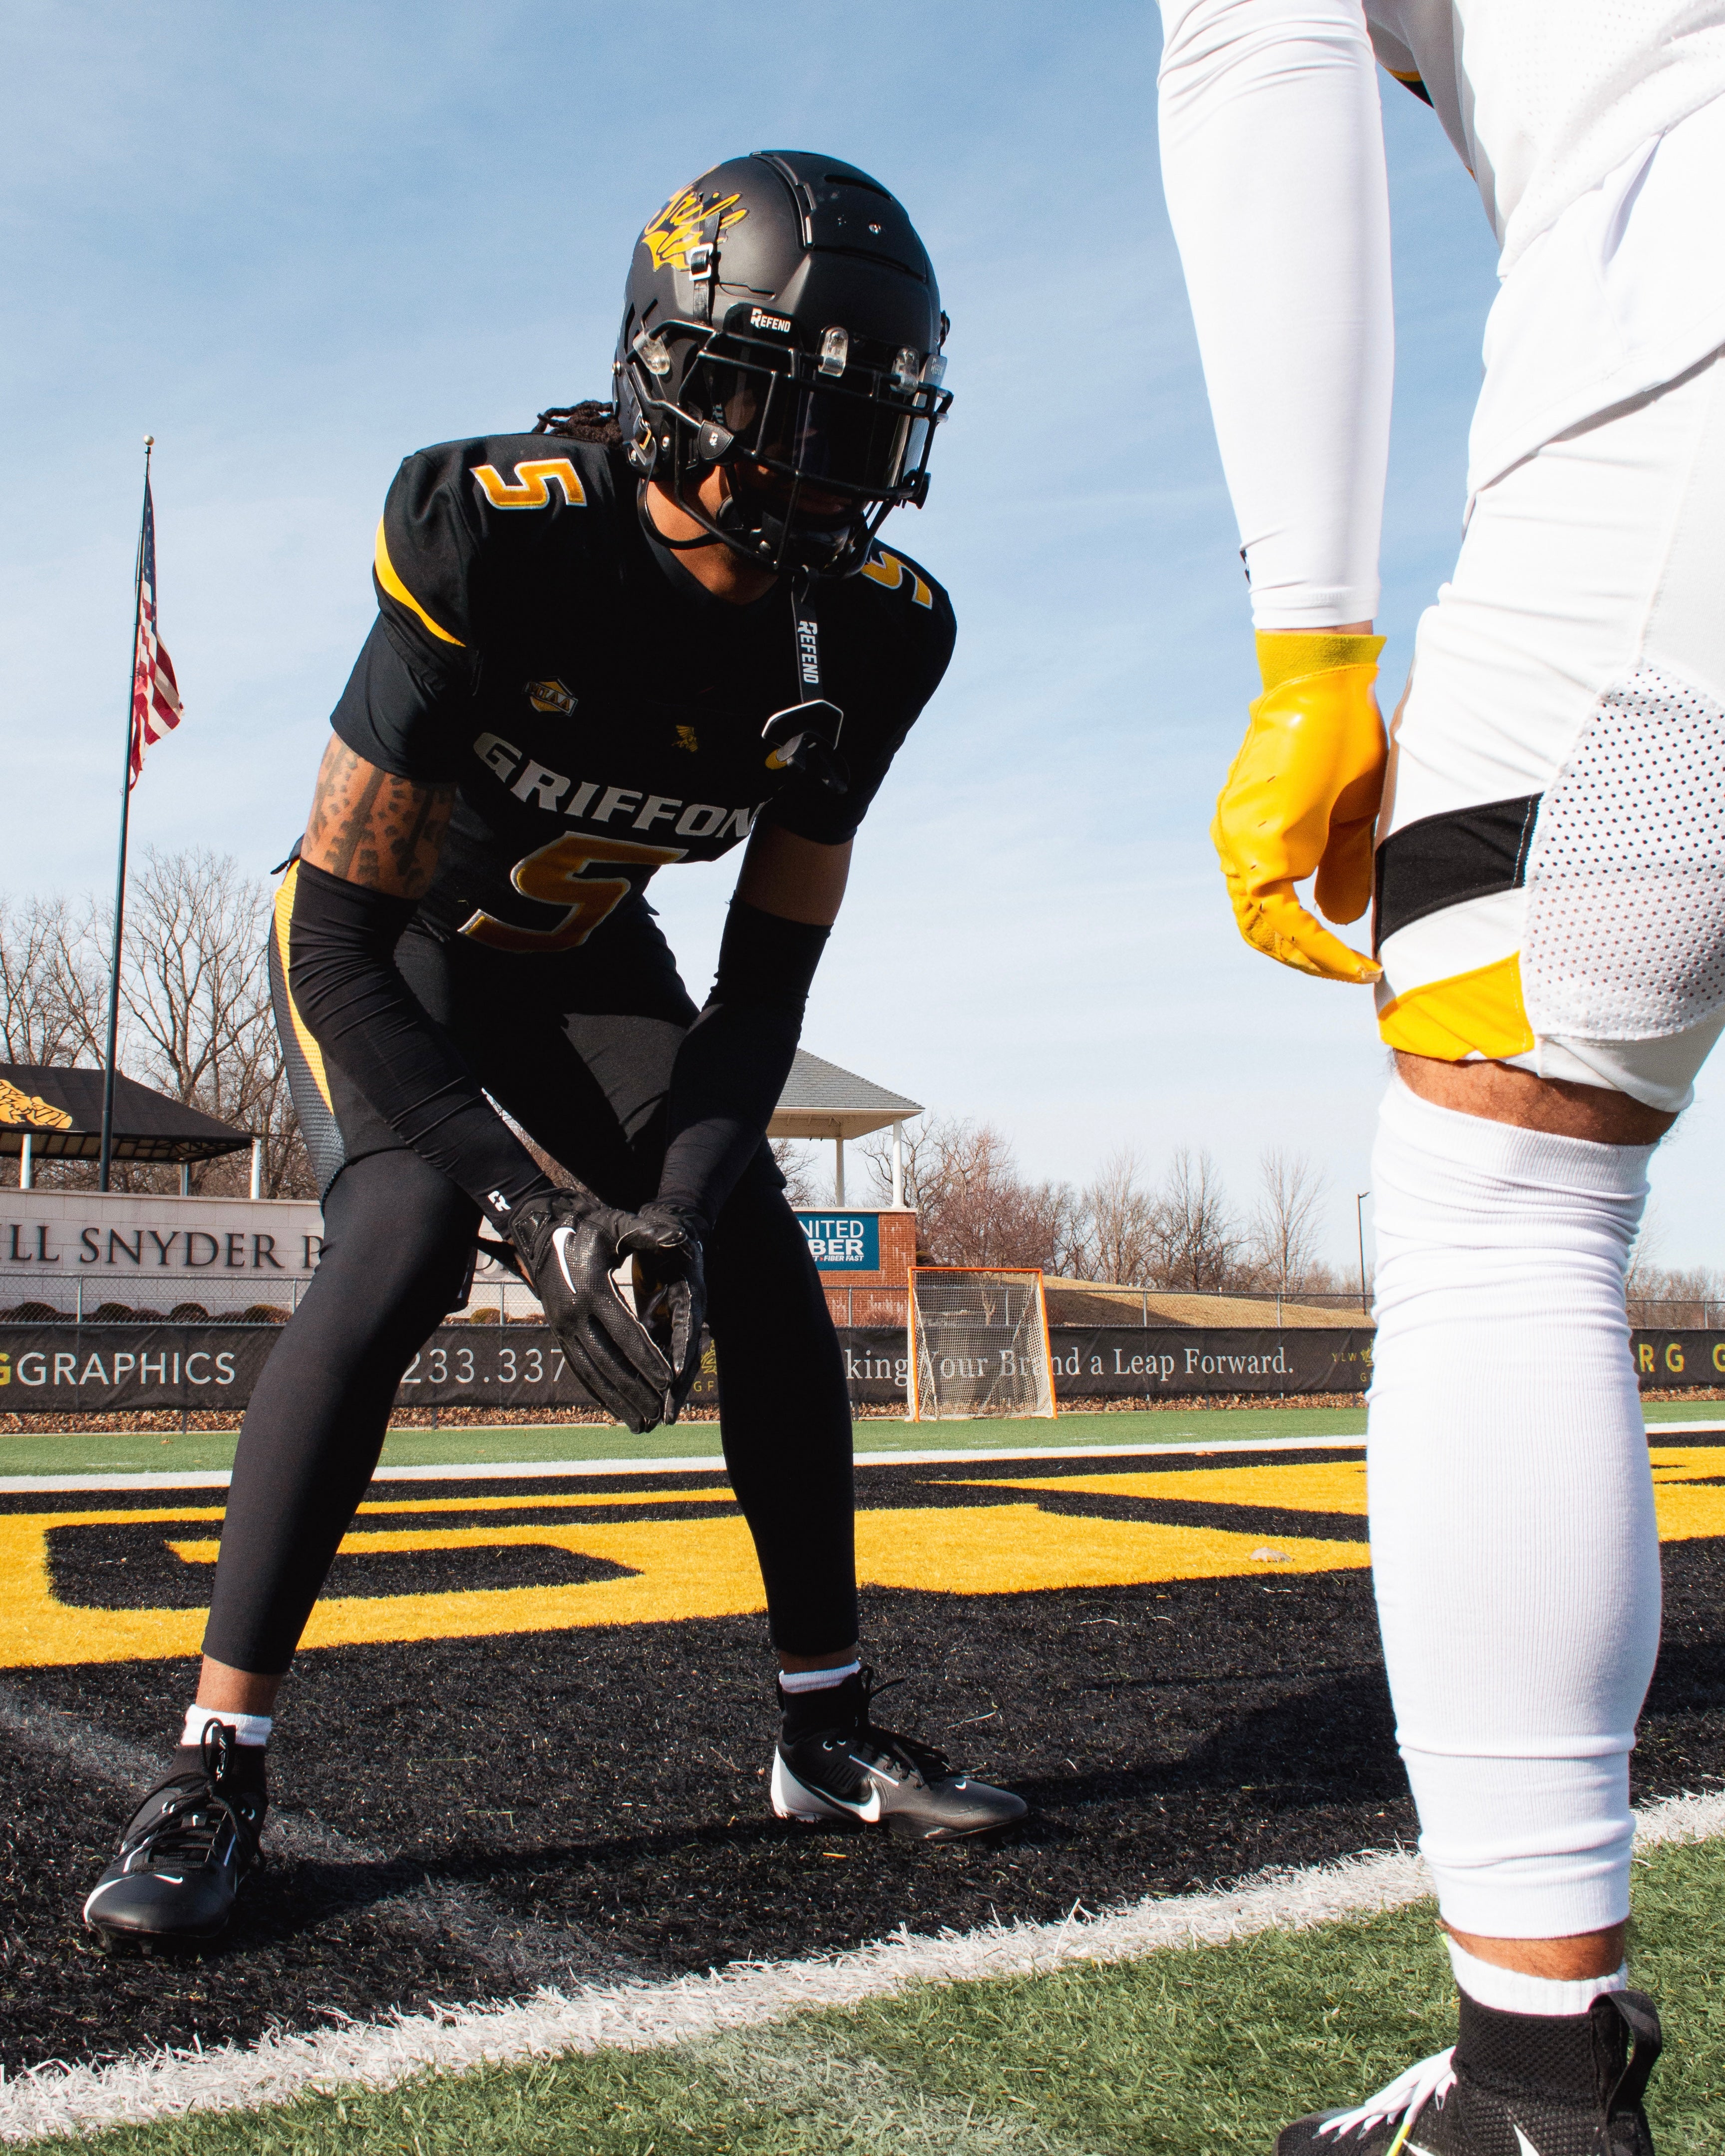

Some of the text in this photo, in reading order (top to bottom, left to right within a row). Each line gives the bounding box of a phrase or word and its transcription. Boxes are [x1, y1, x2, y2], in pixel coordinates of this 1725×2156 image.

[750, 307, 791, 333] REFEND
[469, 458, 588, 510] 5
[797, 620, 819, 684] REFEND
[473, 732, 765, 838] GRIFFON
[457, 831, 689, 953] 5
[0, 1224, 59, 1261] LL
[80, 1227, 285, 1268] SNYDER
[808, 1239, 864, 1255] BER
[844, 1349, 908, 1386] king
[1090, 1355, 1104, 1375] a
[1113, 1348, 1174, 1381] Leap
[1184, 1346, 1294, 1374] Forward.
